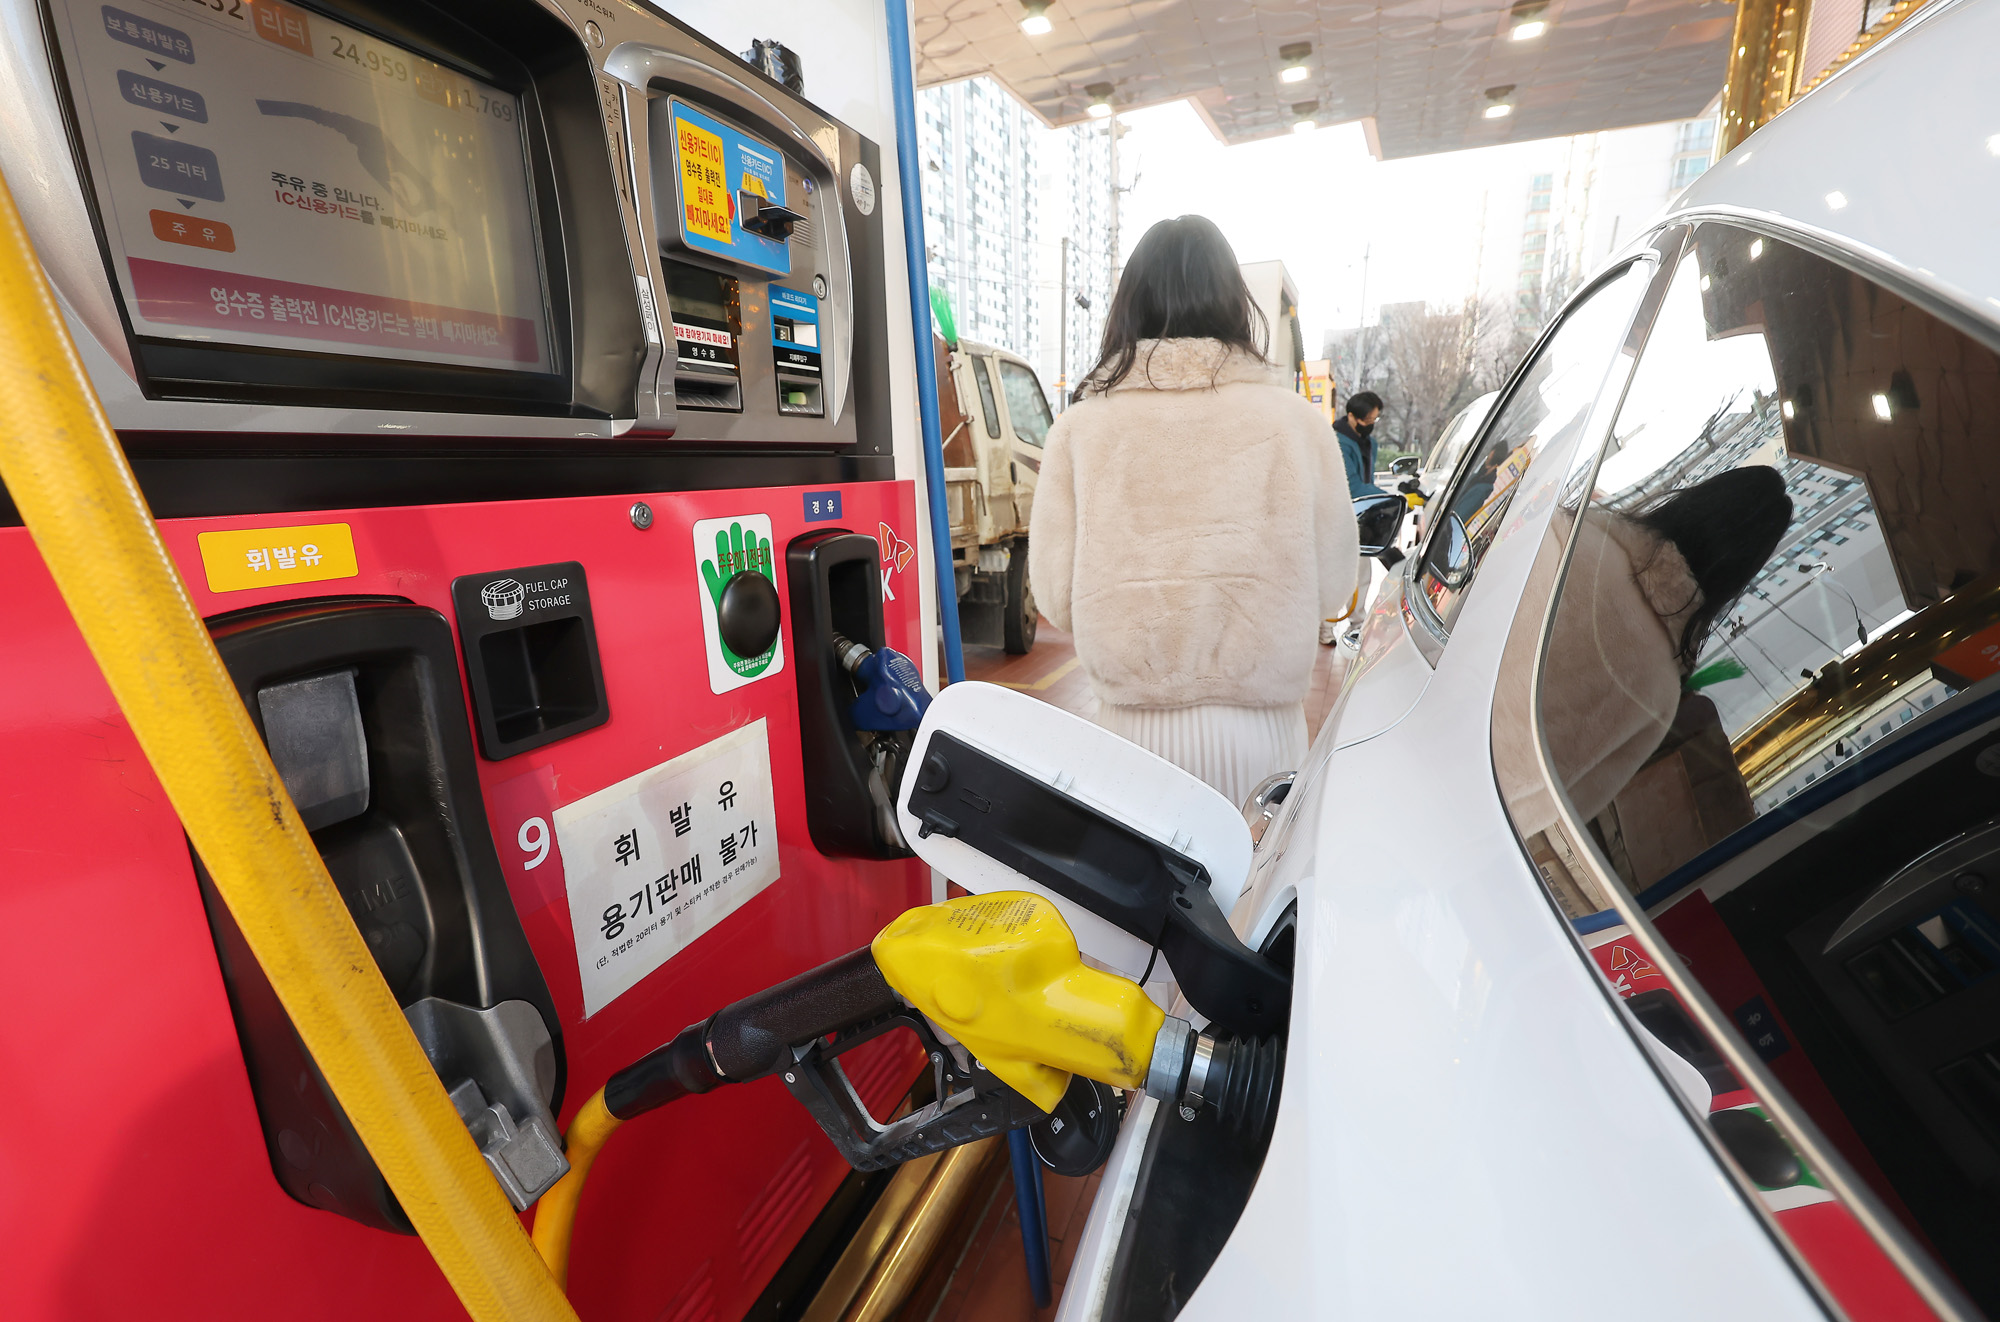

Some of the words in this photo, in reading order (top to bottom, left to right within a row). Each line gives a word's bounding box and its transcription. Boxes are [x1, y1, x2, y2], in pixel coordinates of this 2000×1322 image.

[106, 15, 191, 56] 보통휘발유
[259, 7, 305, 46] 리터
[330, 35, 408, 82] 24.959
[131, 82, 197, 113] 신용카드
[464, 89, 512, 122] 1,769
[680, 129, 722, 166] 신용카드(IC)
[150, 155, 171, 170] 25
[175, 161, 208, 182] 리터
[685, 159, 703, 181] 영수증
[271, 171, 306, 193] 주유
[311, 181, 329, 199] 중
[333, 187, 385, 211] 입니다.
[274, 190, 375, 226] IC신용카드를
[686, 203, 729, 235] 빼지마세요!
[210, 287, 266, 320] 영수증
[269, 294, 320, 326] 출력전
[322, 303, 410, 337] IC신용카드는
[413, 315, 440, 341] 절대
[441, 320, 500, 346] 빼지마세요
[641, 288, 656, 333] 삼성페이
[245, 543, 323, 572] 휘발유
[525, 581, 549, 594] FUEL
[550, 578, 568, 590] CAP
[528, 594, 571, 611] STORAGE
[517, 816, 551, 871] 9
[600, 853, 703, 941] 용기판매
[718, 820, 758, 866] 불가
[611, 938, 634, 957] 적법한
[635, 921, 658, 943] 20리터
[659, 911, 673, 927] 용기
[683, 892, 702, 911] 스티커
